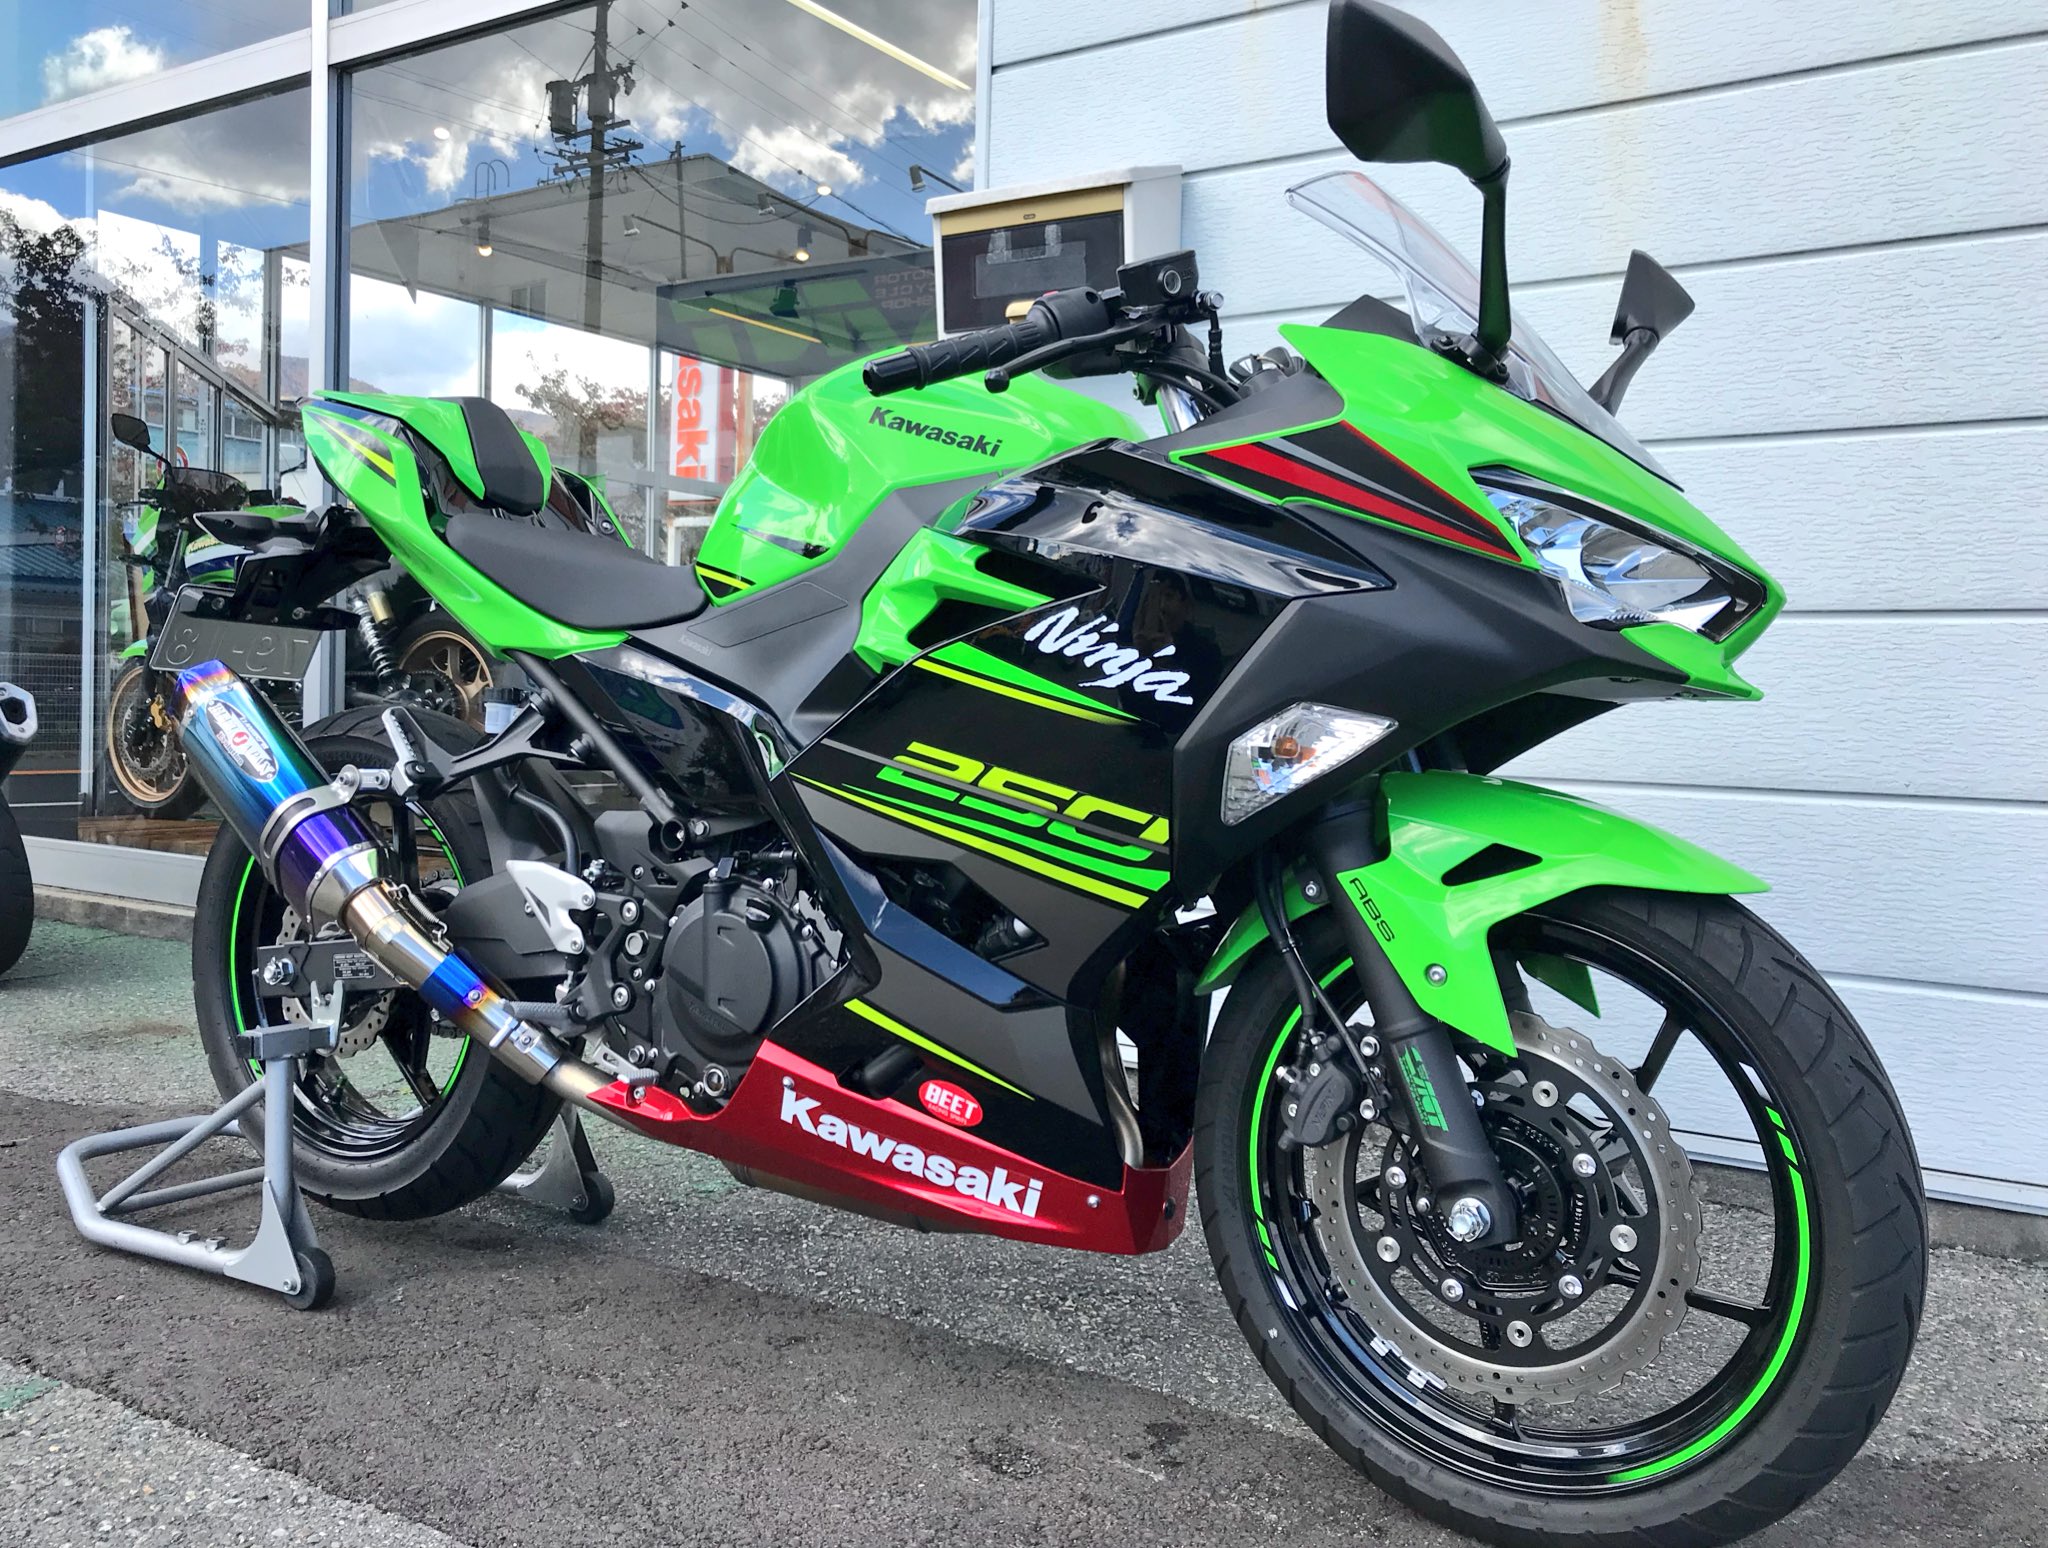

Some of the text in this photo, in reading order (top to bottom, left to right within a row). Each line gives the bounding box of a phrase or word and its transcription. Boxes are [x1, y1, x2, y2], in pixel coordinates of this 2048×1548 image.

[868, 406, 1003, 457] Kawasaki
[1024, 606, 1194, 705] Ninja
[876, 741, 1170, 862] 250
[1349, 877, 1395, 942] ABS
[924, 1082, 978, 1120] BEET
[780, 1088, 1044, 1218] Kawasaki
